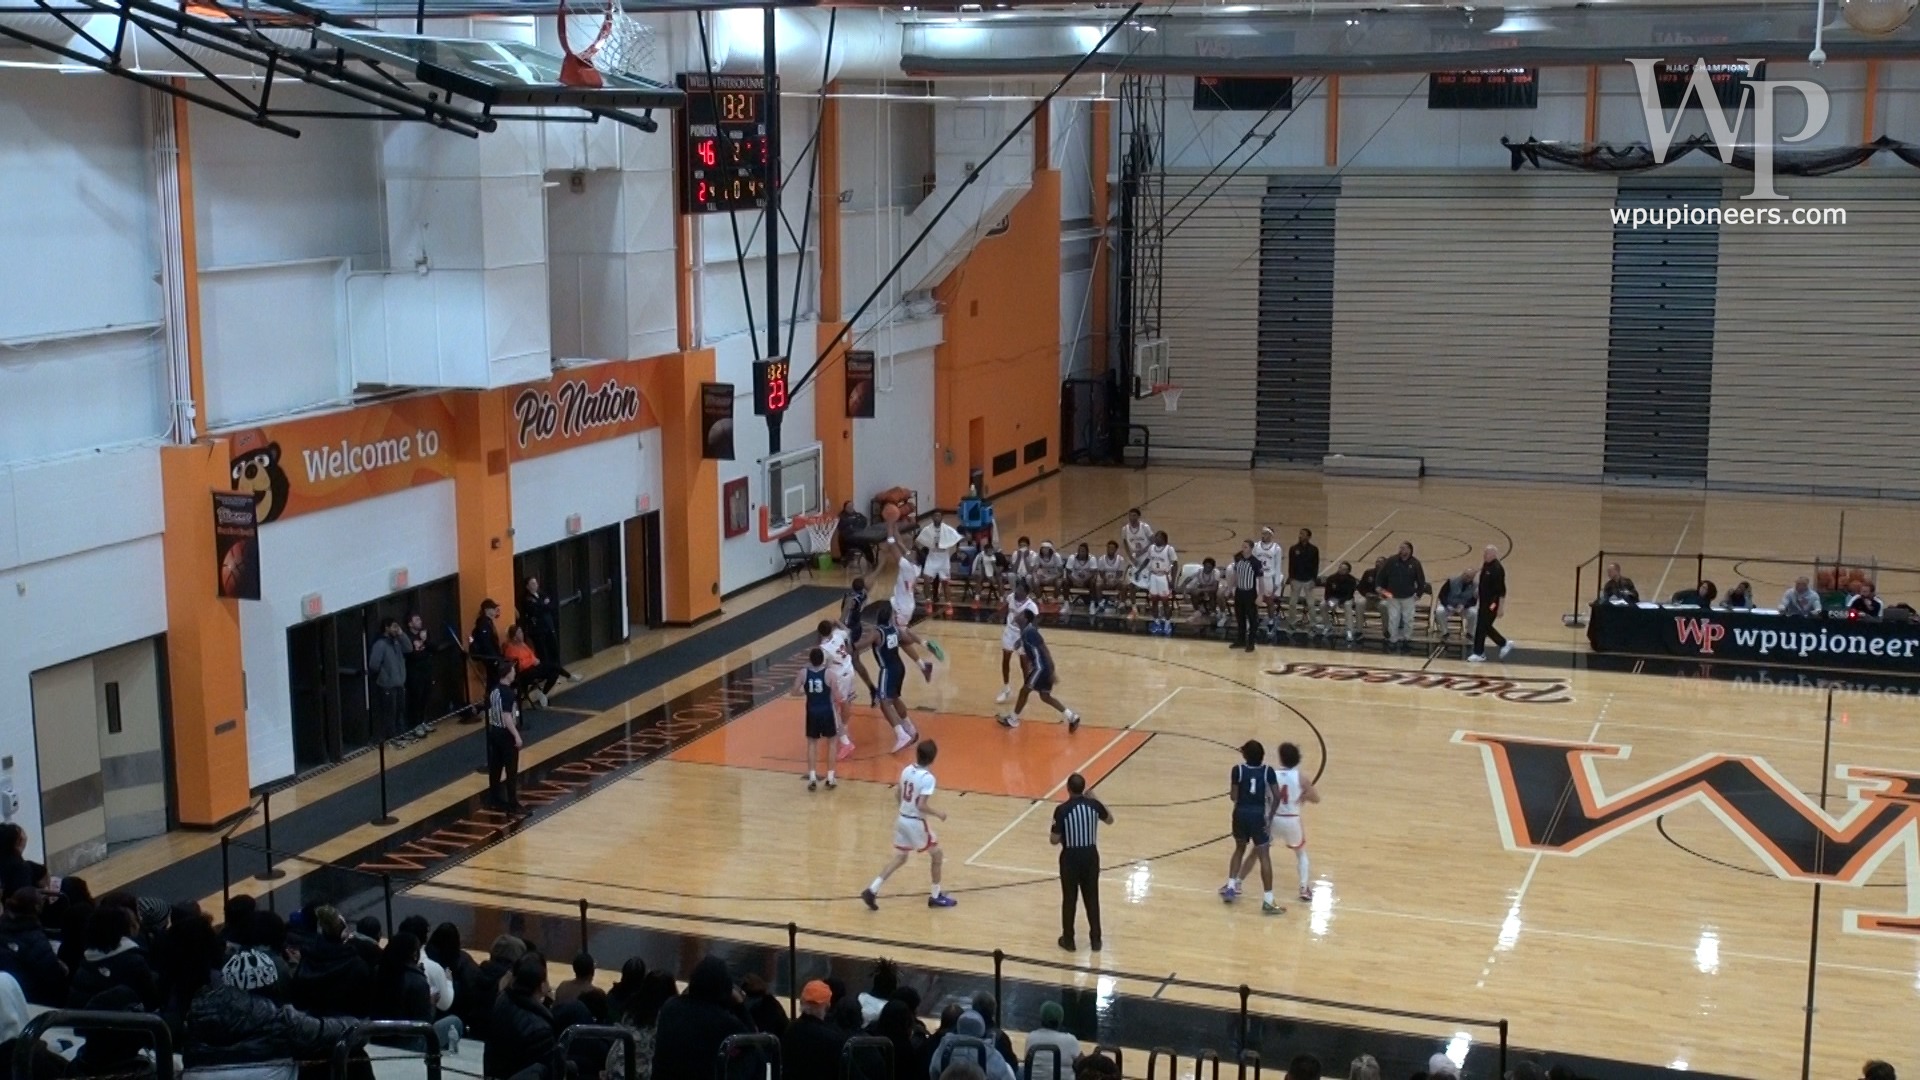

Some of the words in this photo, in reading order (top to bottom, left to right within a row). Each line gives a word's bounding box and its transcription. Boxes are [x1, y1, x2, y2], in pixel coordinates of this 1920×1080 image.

[698, 140, 716, 166] 46
[769, 380, 785, 409] 23
[514, 387, 560, 448] Pio
[558, 379, 639, 438] Nation
[303, 437, 411, 484] Welcome
[415, 428, 439, 459] to
[1674, 616, 1725, 654] WP
[1733, 628, 1920, 657] wpupioneer
[808, 678, 823, 694] 13
[1250, 778, 1257, 795] 1
[355, 780, 592, 870] WILLIM
